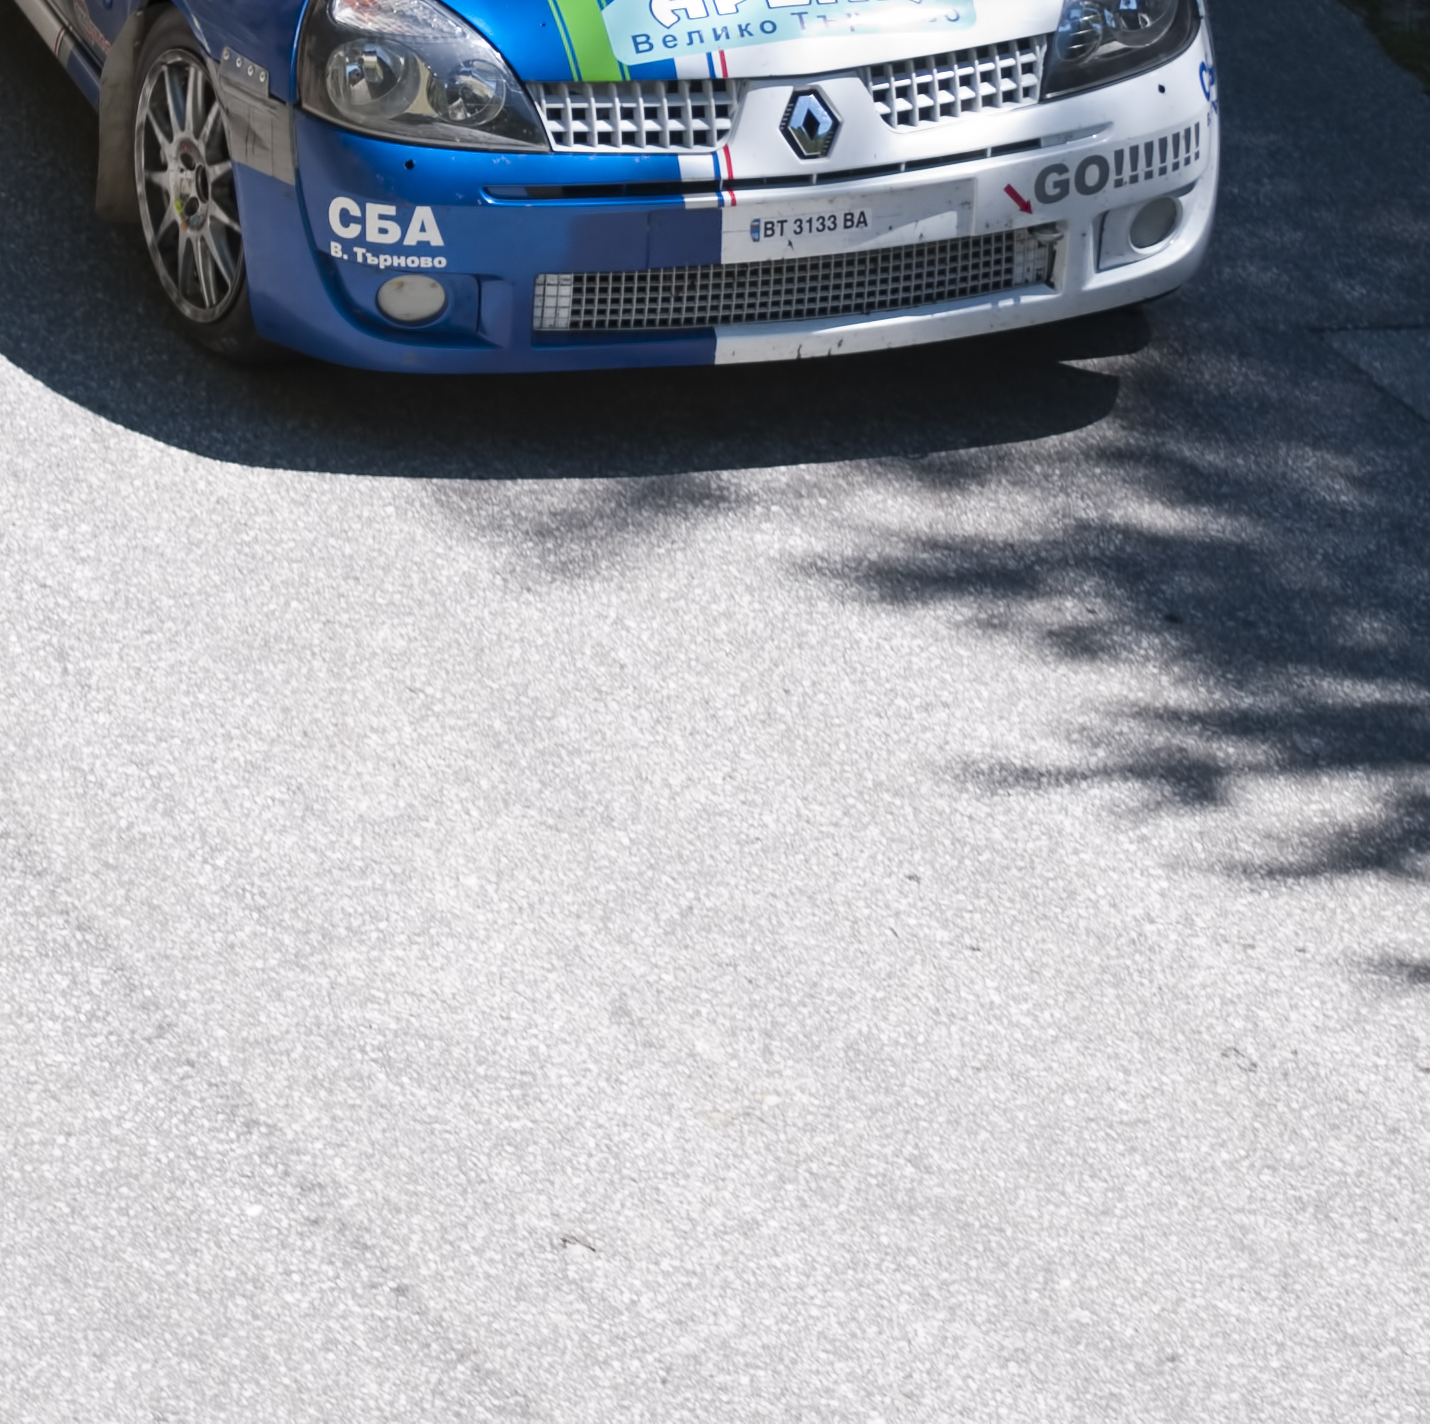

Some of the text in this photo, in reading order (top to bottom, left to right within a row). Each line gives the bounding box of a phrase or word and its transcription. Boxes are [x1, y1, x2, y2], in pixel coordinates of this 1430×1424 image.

[630, 19, 778, 55] Велико
[328, 196, 445, 247] СБА
[763, 210, 869, 238] BT 3133 BA
[329, 241, 447, 269] В. Търново
